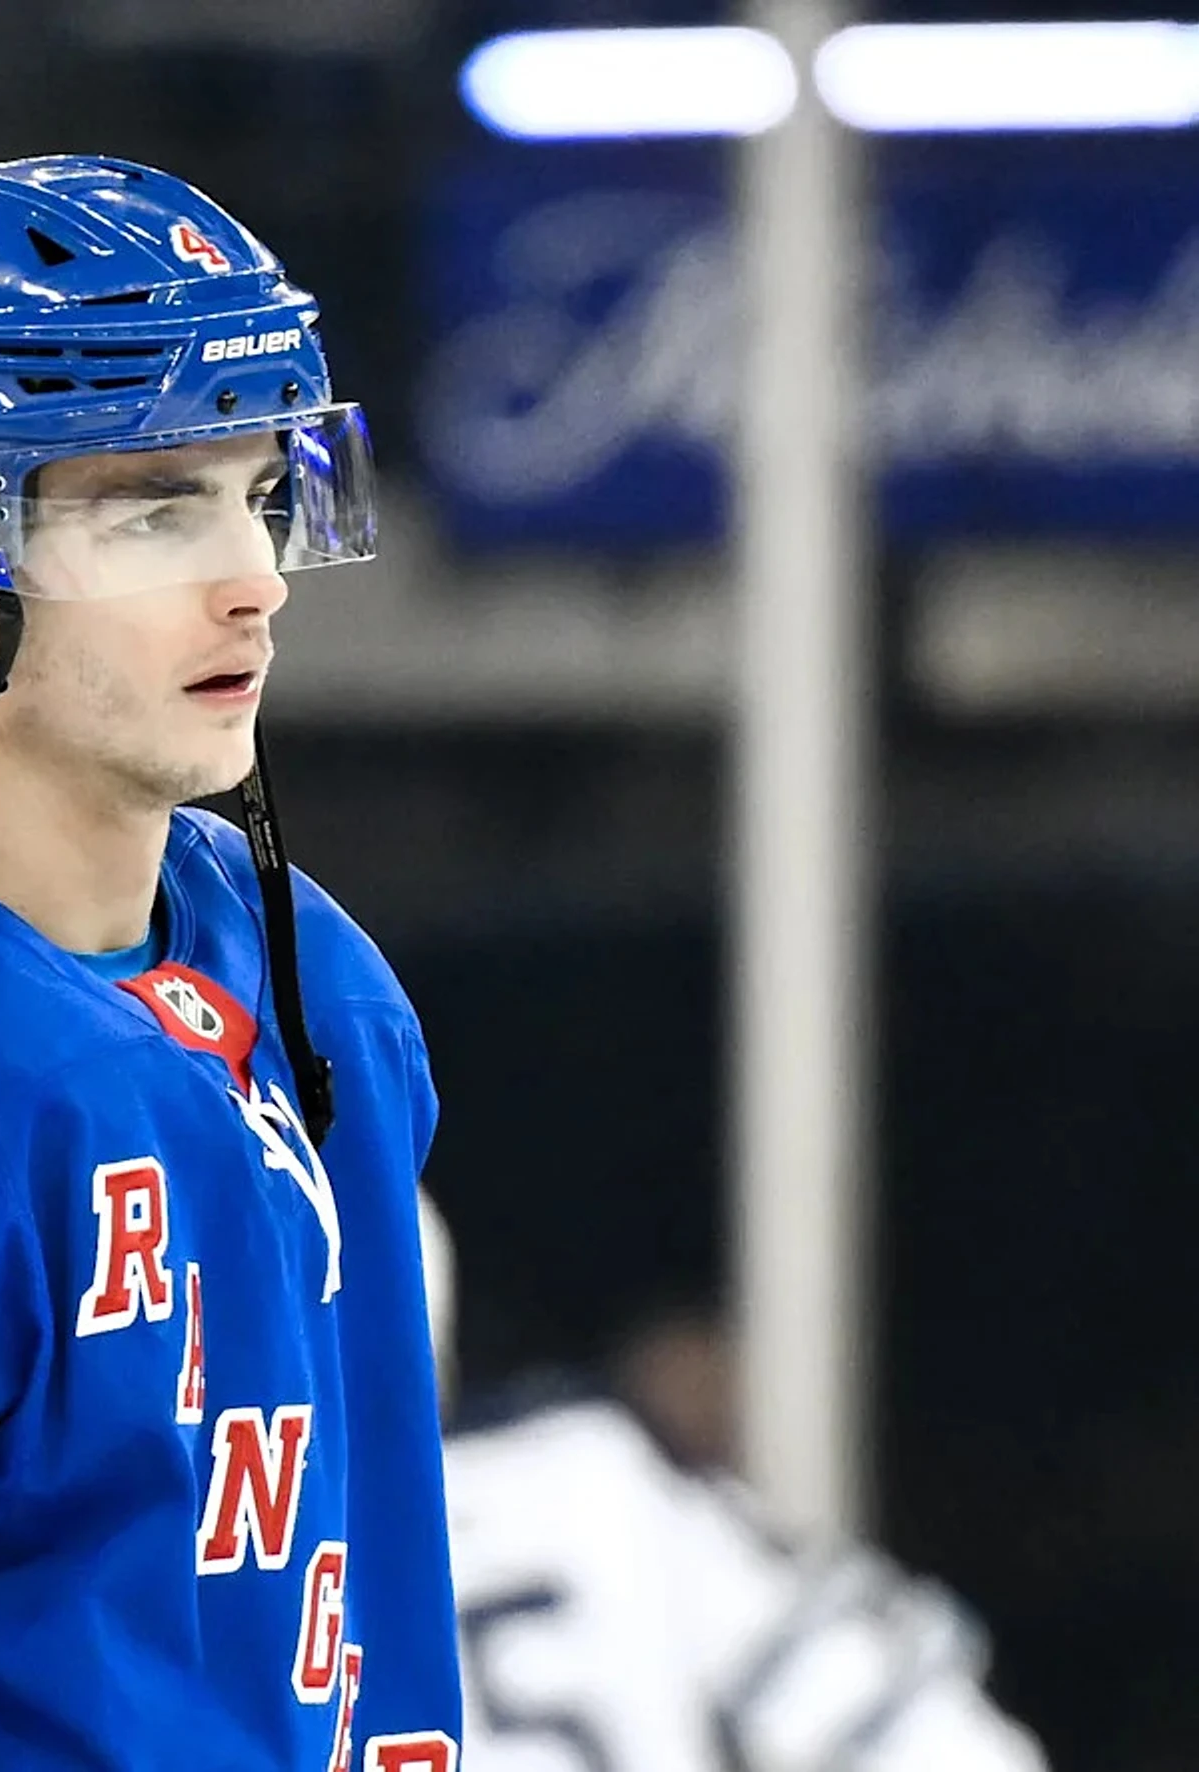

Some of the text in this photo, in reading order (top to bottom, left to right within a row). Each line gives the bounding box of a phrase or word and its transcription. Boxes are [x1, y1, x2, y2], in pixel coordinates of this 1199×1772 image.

[172, 219, 230, 274] 4
[202, 328, 301, 362] BAUER
[76, 1157, 461, 1772] RANGE
